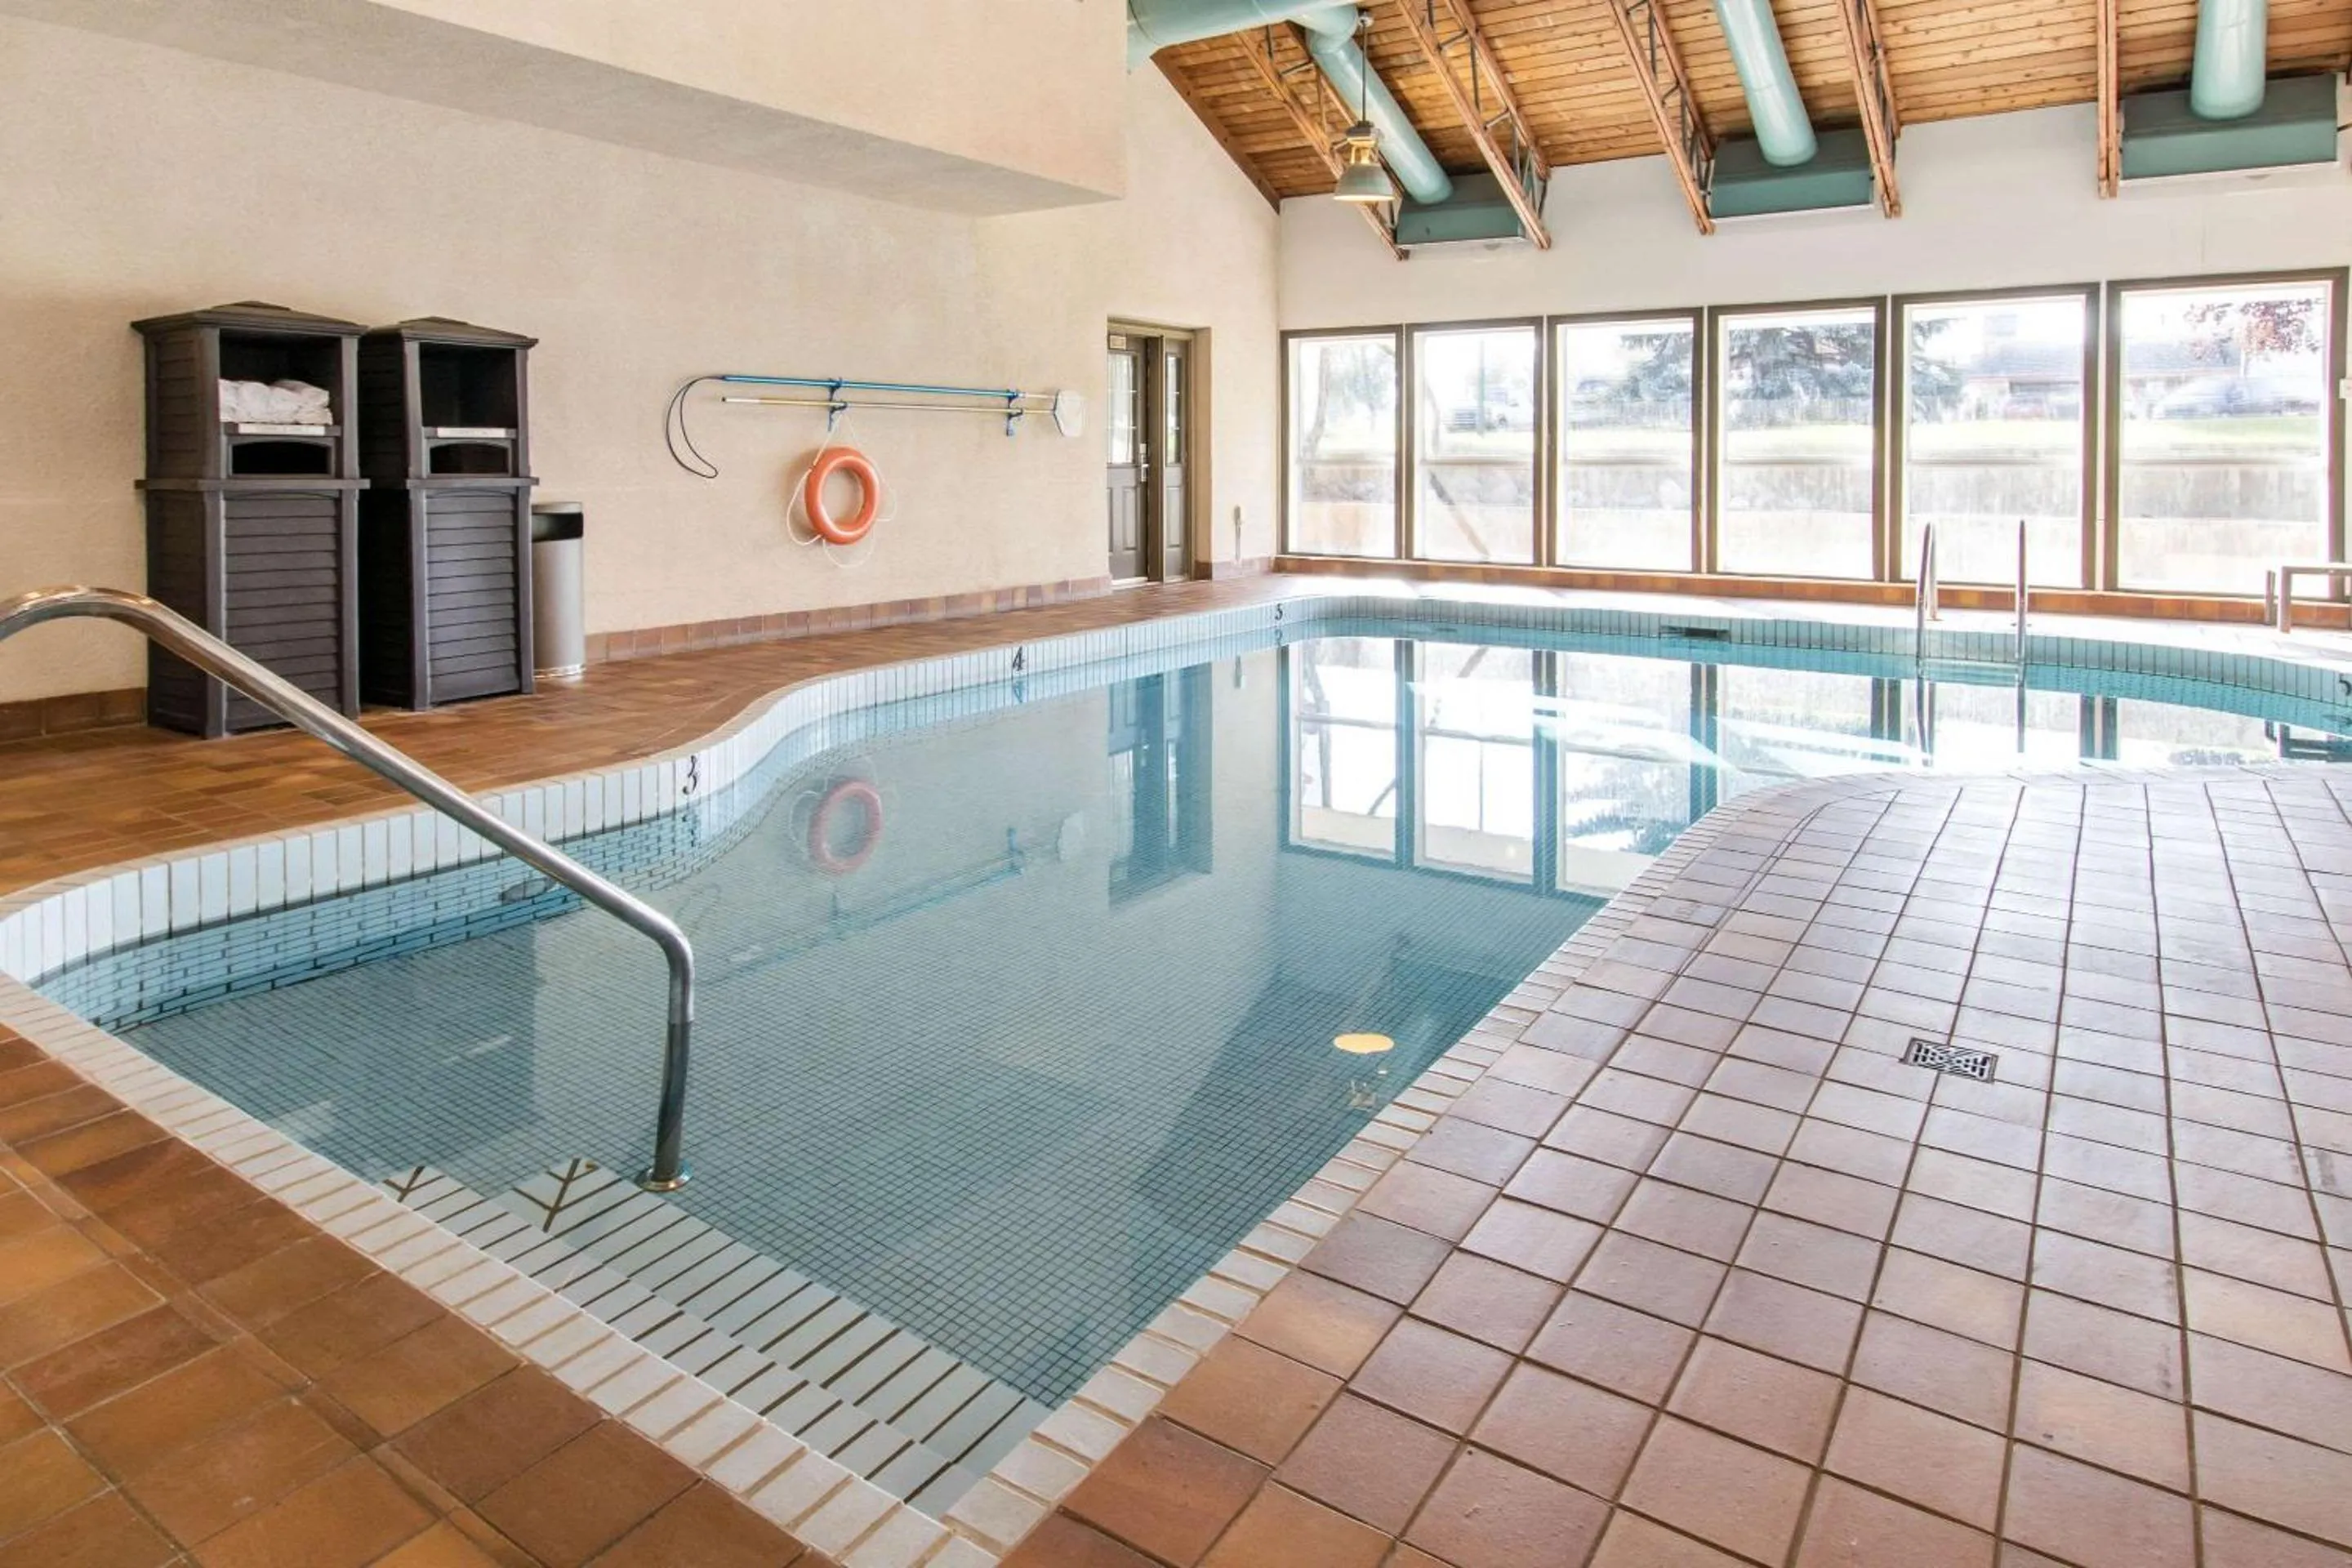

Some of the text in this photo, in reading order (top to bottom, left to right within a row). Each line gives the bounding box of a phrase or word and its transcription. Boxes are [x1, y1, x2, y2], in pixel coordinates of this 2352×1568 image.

[1275, 603, 1284, 621] 5
[1012, 645, 1025, 671] 4
[683, 755, 697, 795] 3
